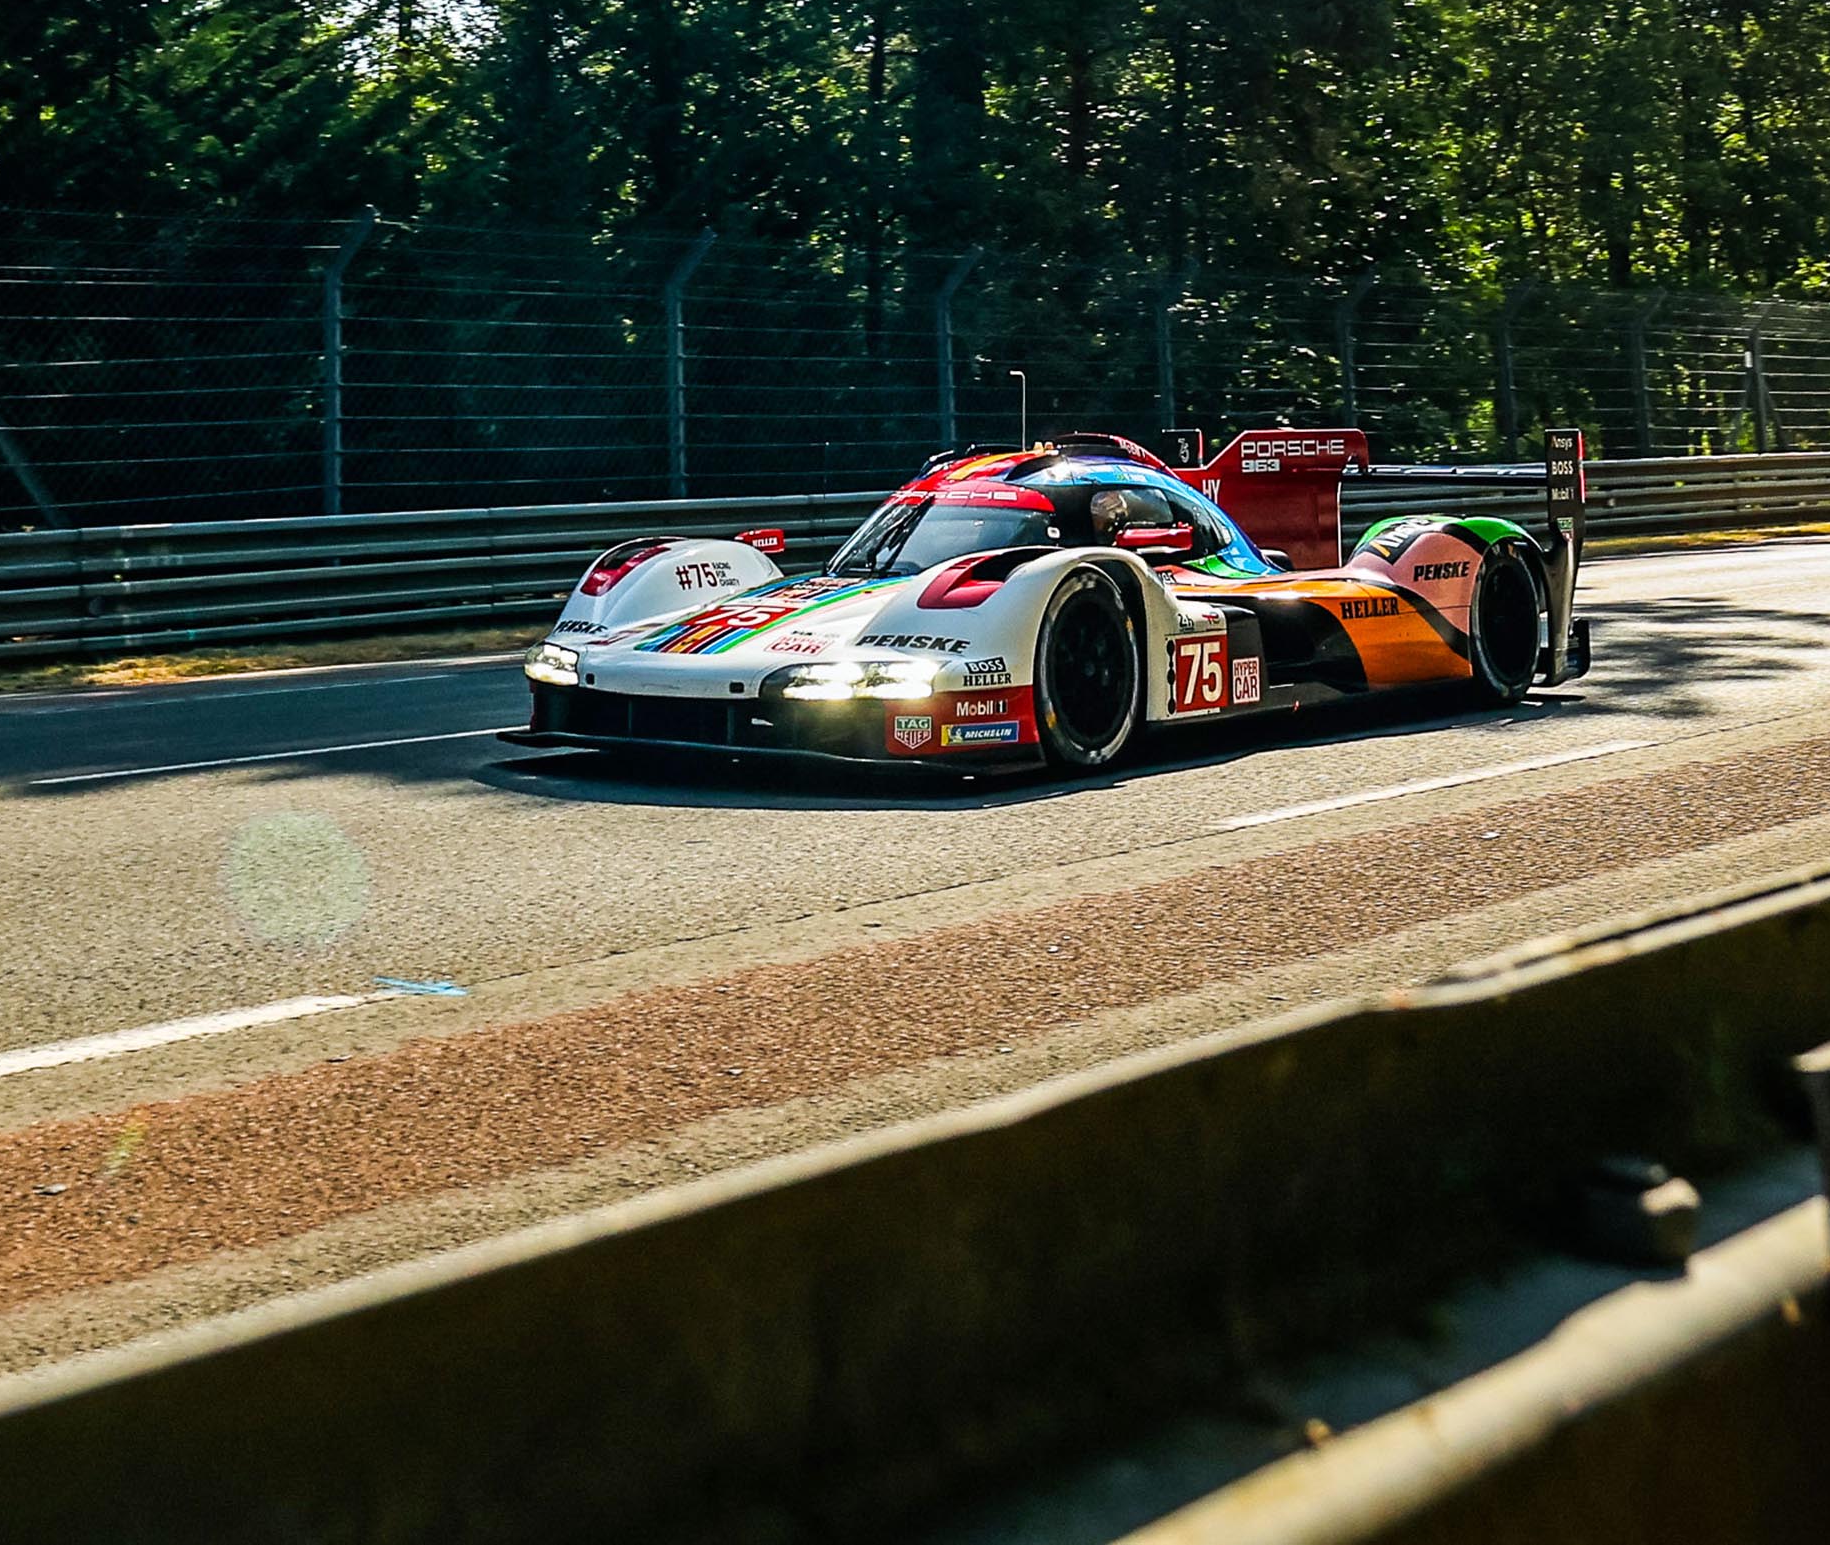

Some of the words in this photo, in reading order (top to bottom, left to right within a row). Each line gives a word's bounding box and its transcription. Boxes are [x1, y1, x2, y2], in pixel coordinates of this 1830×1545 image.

[1241, 440, 1345, 457] PORSCHE
[1242, 459, 1281, 473] 963
[1551, 460, 1574, 475] BOSS
[675, 563, 718, 591] #75
[1413, 561, 1470, 582] PENSKE
[1339, 597, 1400, 619] HELLER
[695, 607, 787, 627] 75
[554, 619, 609, 635] PENSKE
[771, 643, 820, 654] CAR
[855, 635, 970, 654] PENSKE
[970, 659, 1005, 673] BOSS
[1180, 641, 1223, 705] 75
[1234, 661, 1257, 676] HYPER
[963, 672, 1012, 687] HELLER
[1235, 676, 1258, 700] CAR
[956, 700, 994, 717] Mobil
[997, 699, 1006, 714] 1
[899, 718, 929, 729] TAG
[897, 730, 931, 748] HEUER
[964, 727, 1012, 739] MICHELIN
